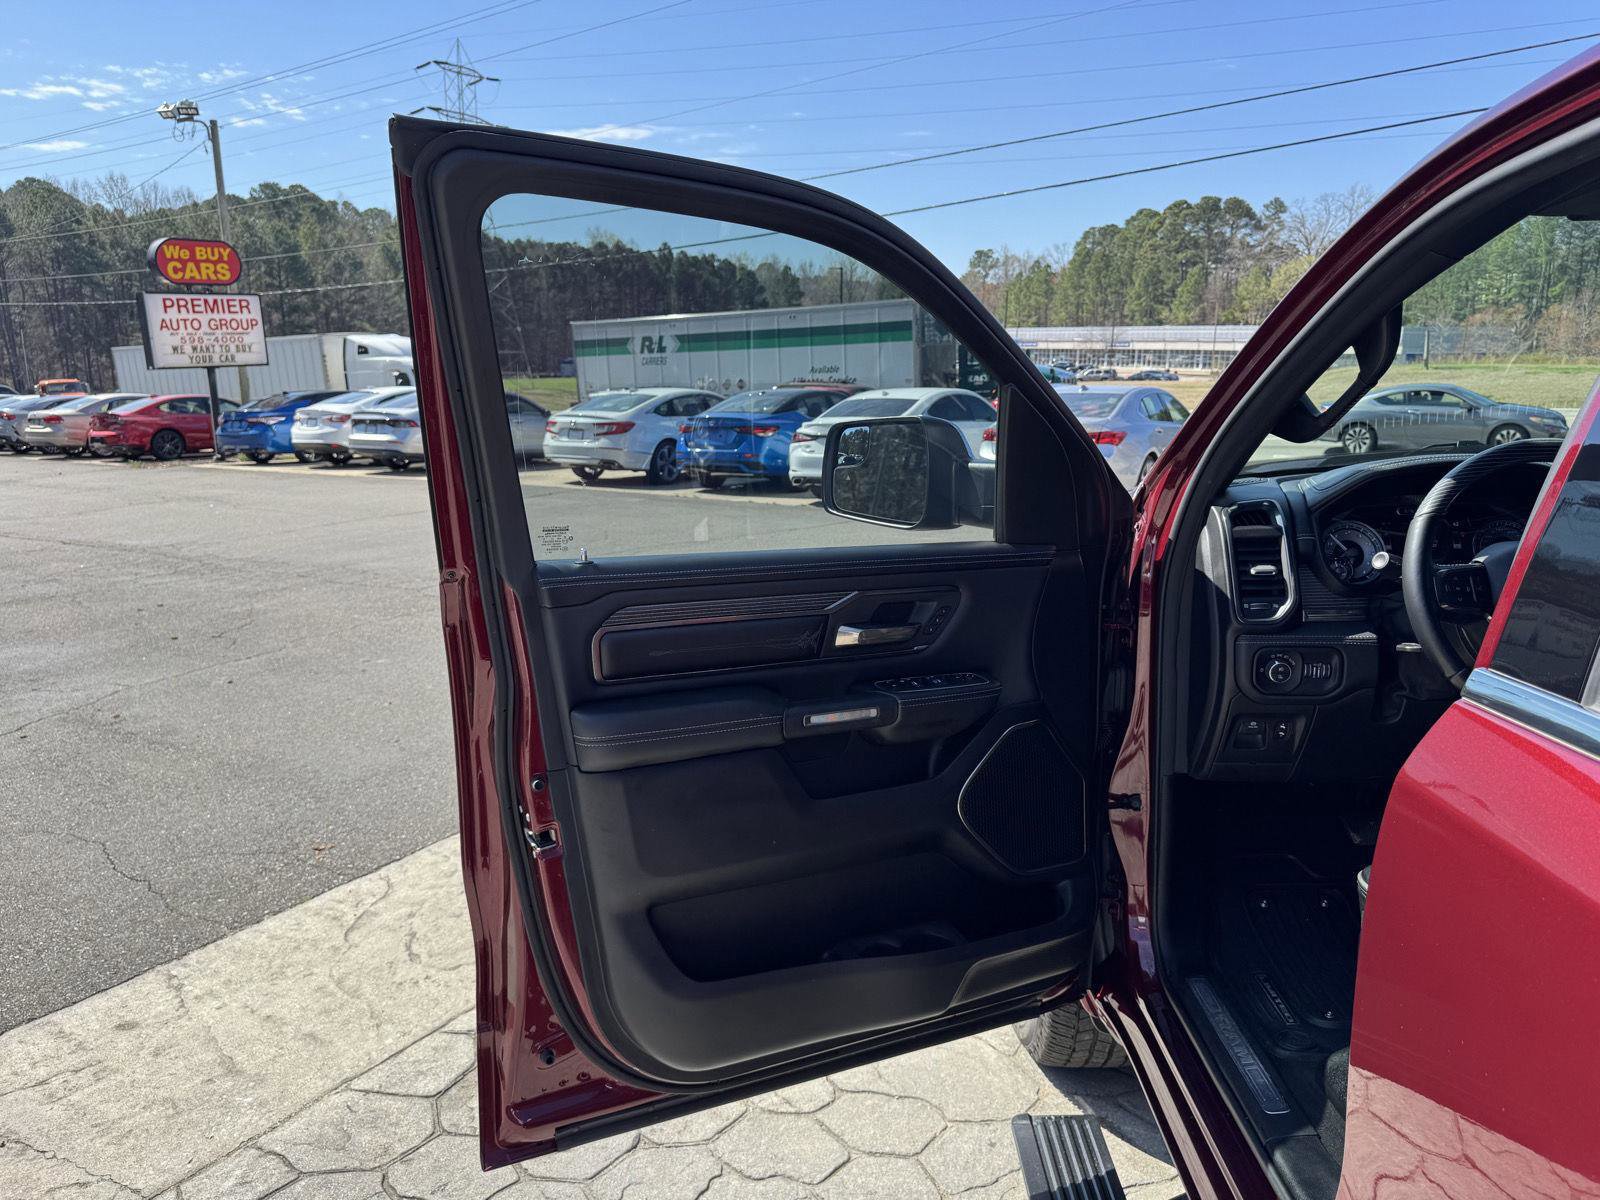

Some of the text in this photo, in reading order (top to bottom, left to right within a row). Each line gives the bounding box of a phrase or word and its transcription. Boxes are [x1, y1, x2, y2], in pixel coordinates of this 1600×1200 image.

[163, 245, 231, 261] We BUY
[167, 261, 232, 281] CARS
[162, 297, 251, 314] PREMIER
[160, 318, 259, 331] AUTO GROUP
[171, 344, 253, 354] WE WANT TO BUY
[188, 354, 237, 364] YOUR CAR
